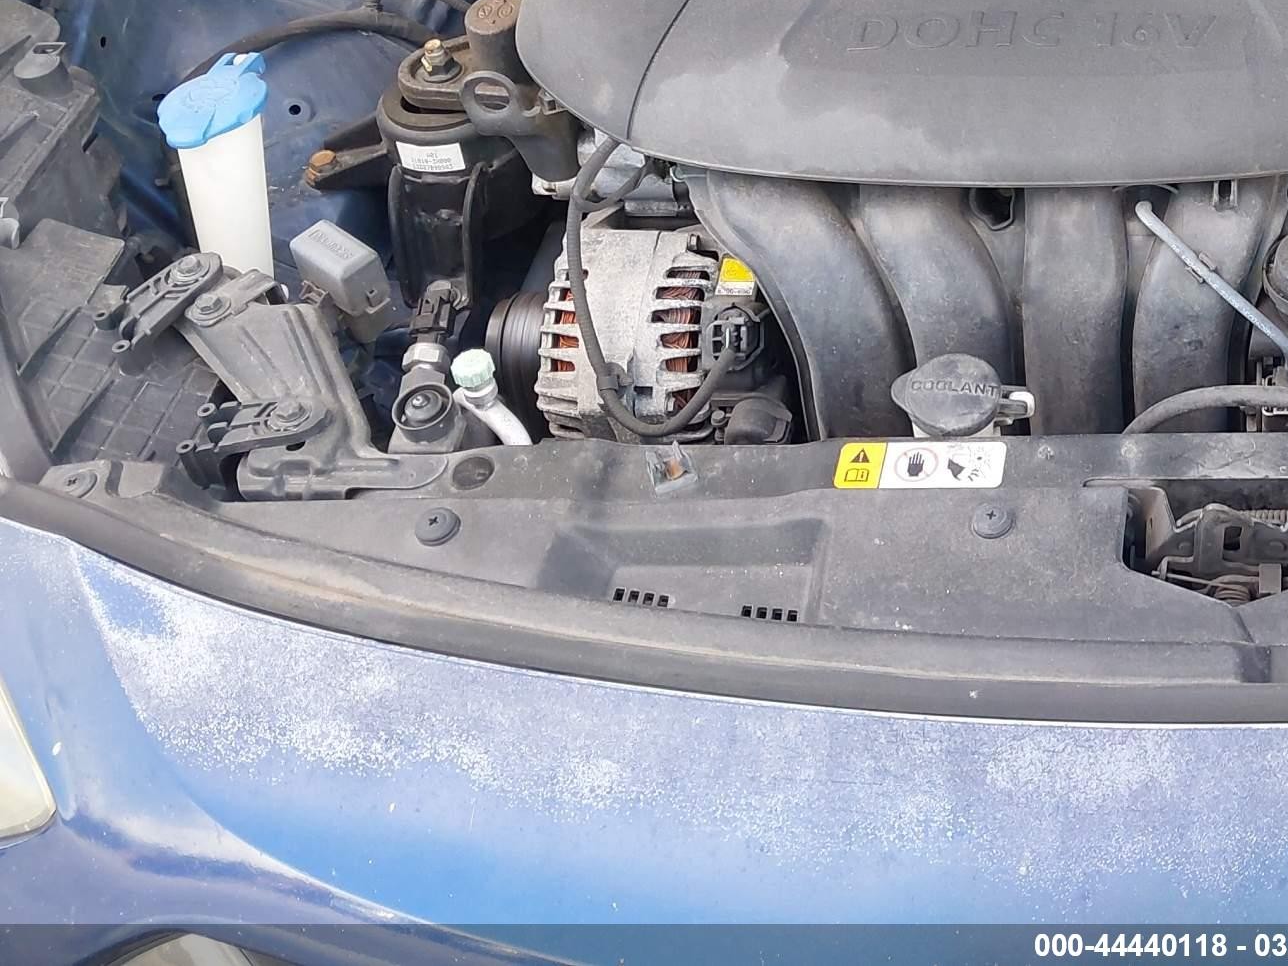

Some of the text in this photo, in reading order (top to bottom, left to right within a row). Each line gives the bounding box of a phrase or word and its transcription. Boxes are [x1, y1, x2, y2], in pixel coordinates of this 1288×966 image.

[847, 11, 1217, 51] DOHC 16V
[910, 379, 999, 398] COOLANT
